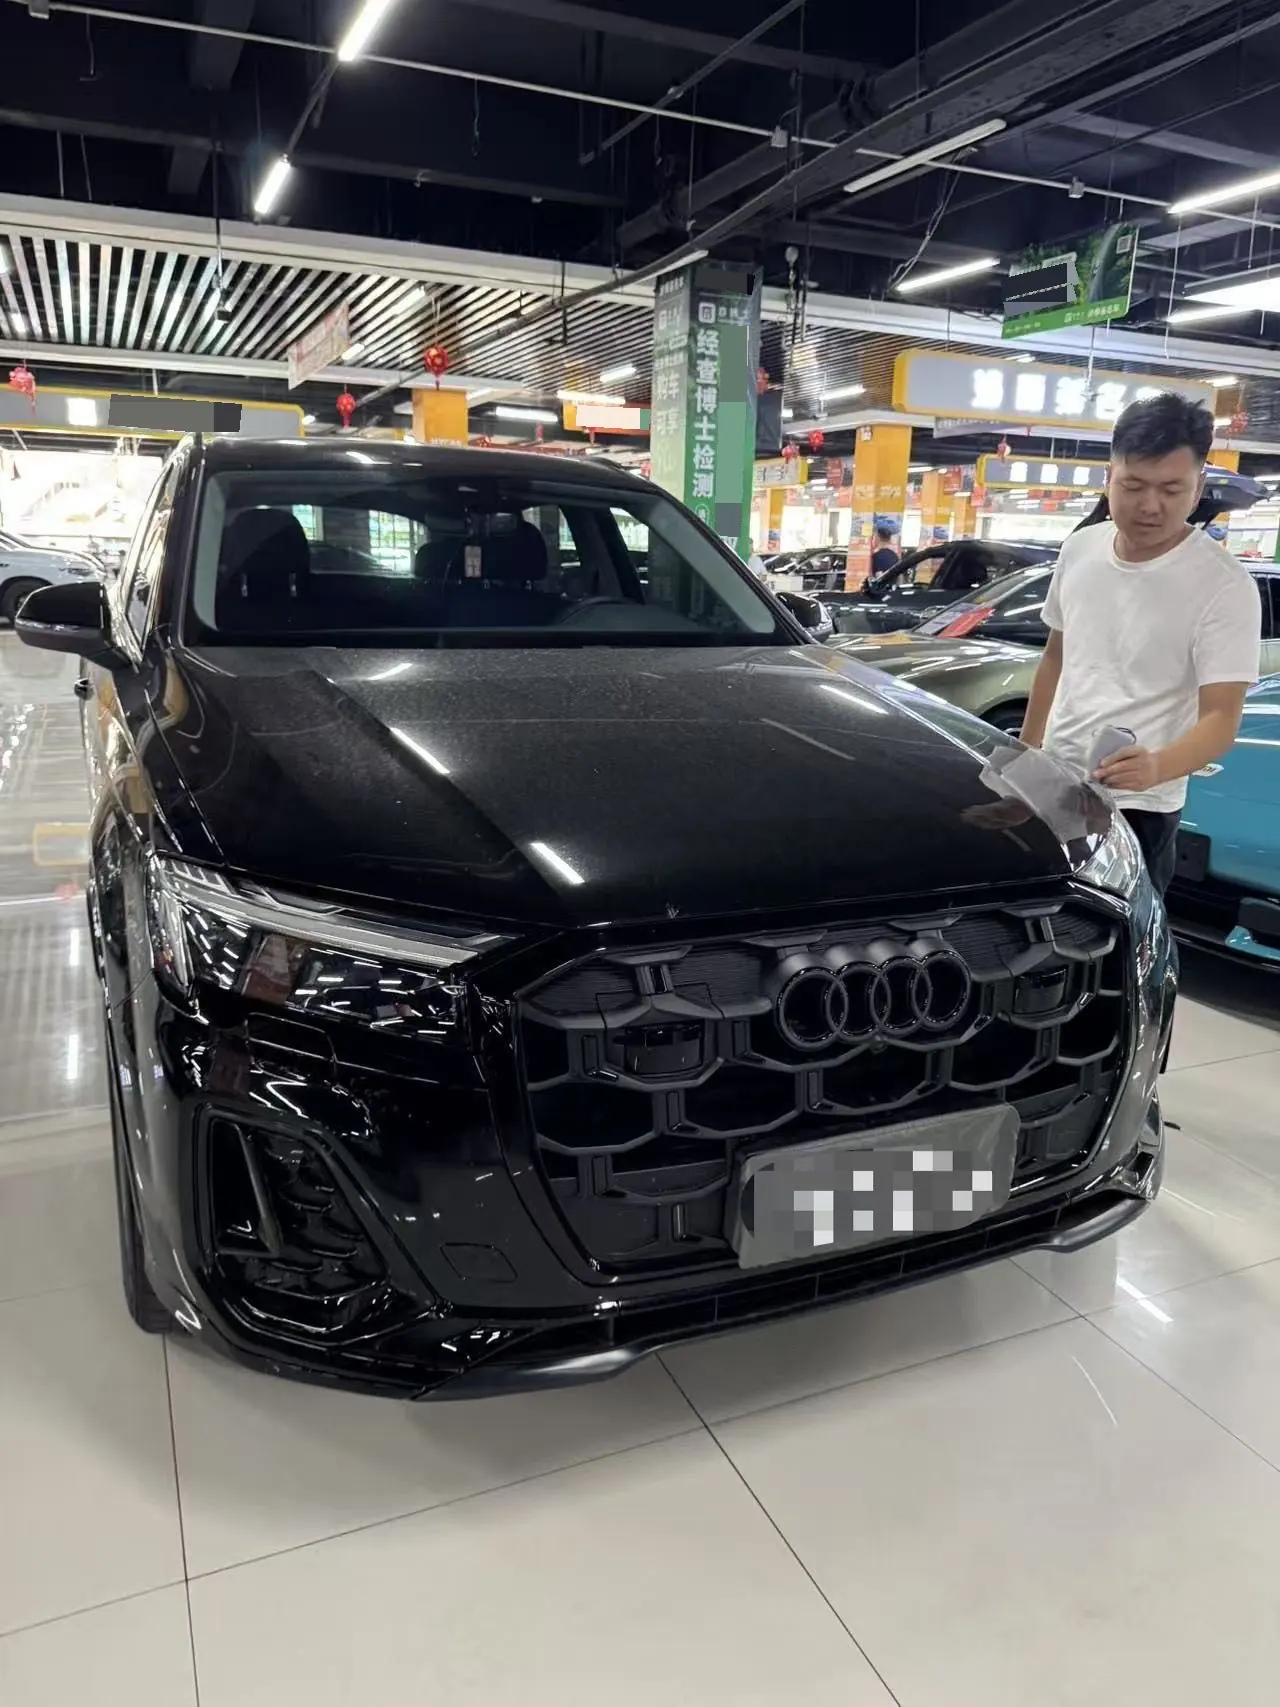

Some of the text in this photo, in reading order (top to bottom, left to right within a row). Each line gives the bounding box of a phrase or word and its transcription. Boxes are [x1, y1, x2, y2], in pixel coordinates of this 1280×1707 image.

[693, 328, 719, 498] 经查博士检测
